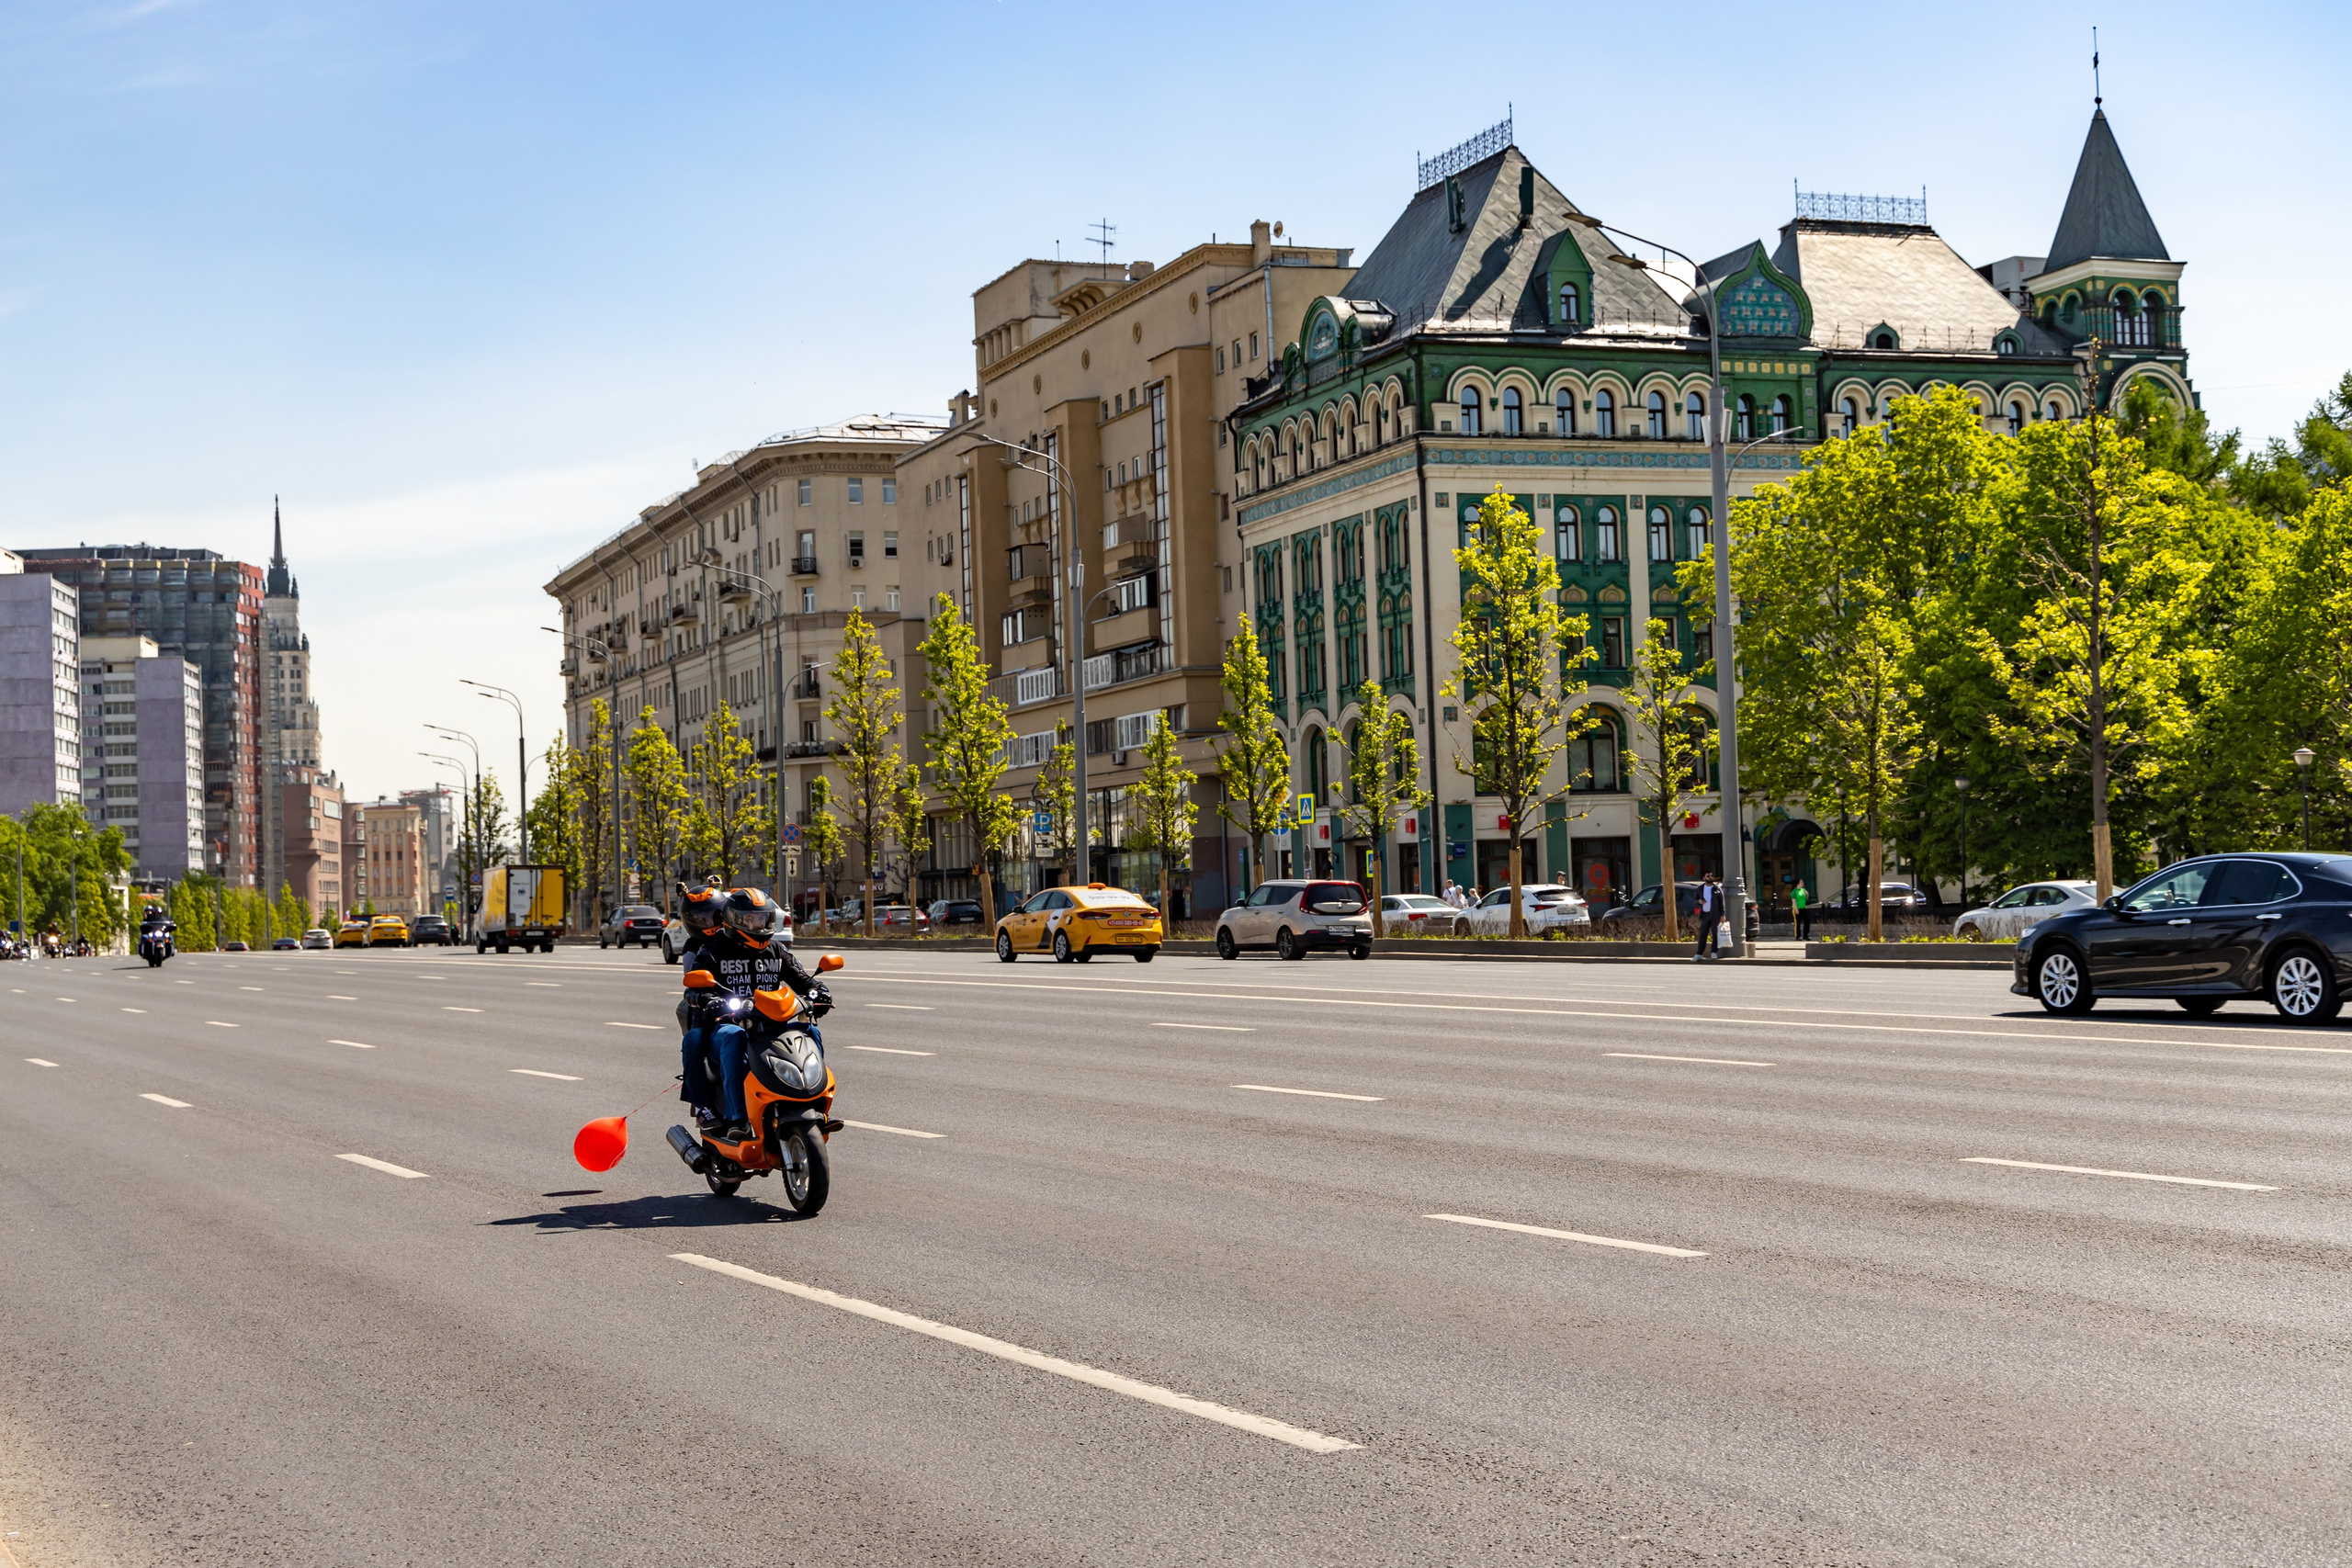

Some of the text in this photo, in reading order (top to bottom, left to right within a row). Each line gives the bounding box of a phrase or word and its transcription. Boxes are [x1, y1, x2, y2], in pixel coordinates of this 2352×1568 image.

[1589, 863, 1609, 889] 9
[720, 959, 750, 974] BEST
[726, 974, 778, 985] CHAM PIONS
[732, 985, 752, 997] LEA
